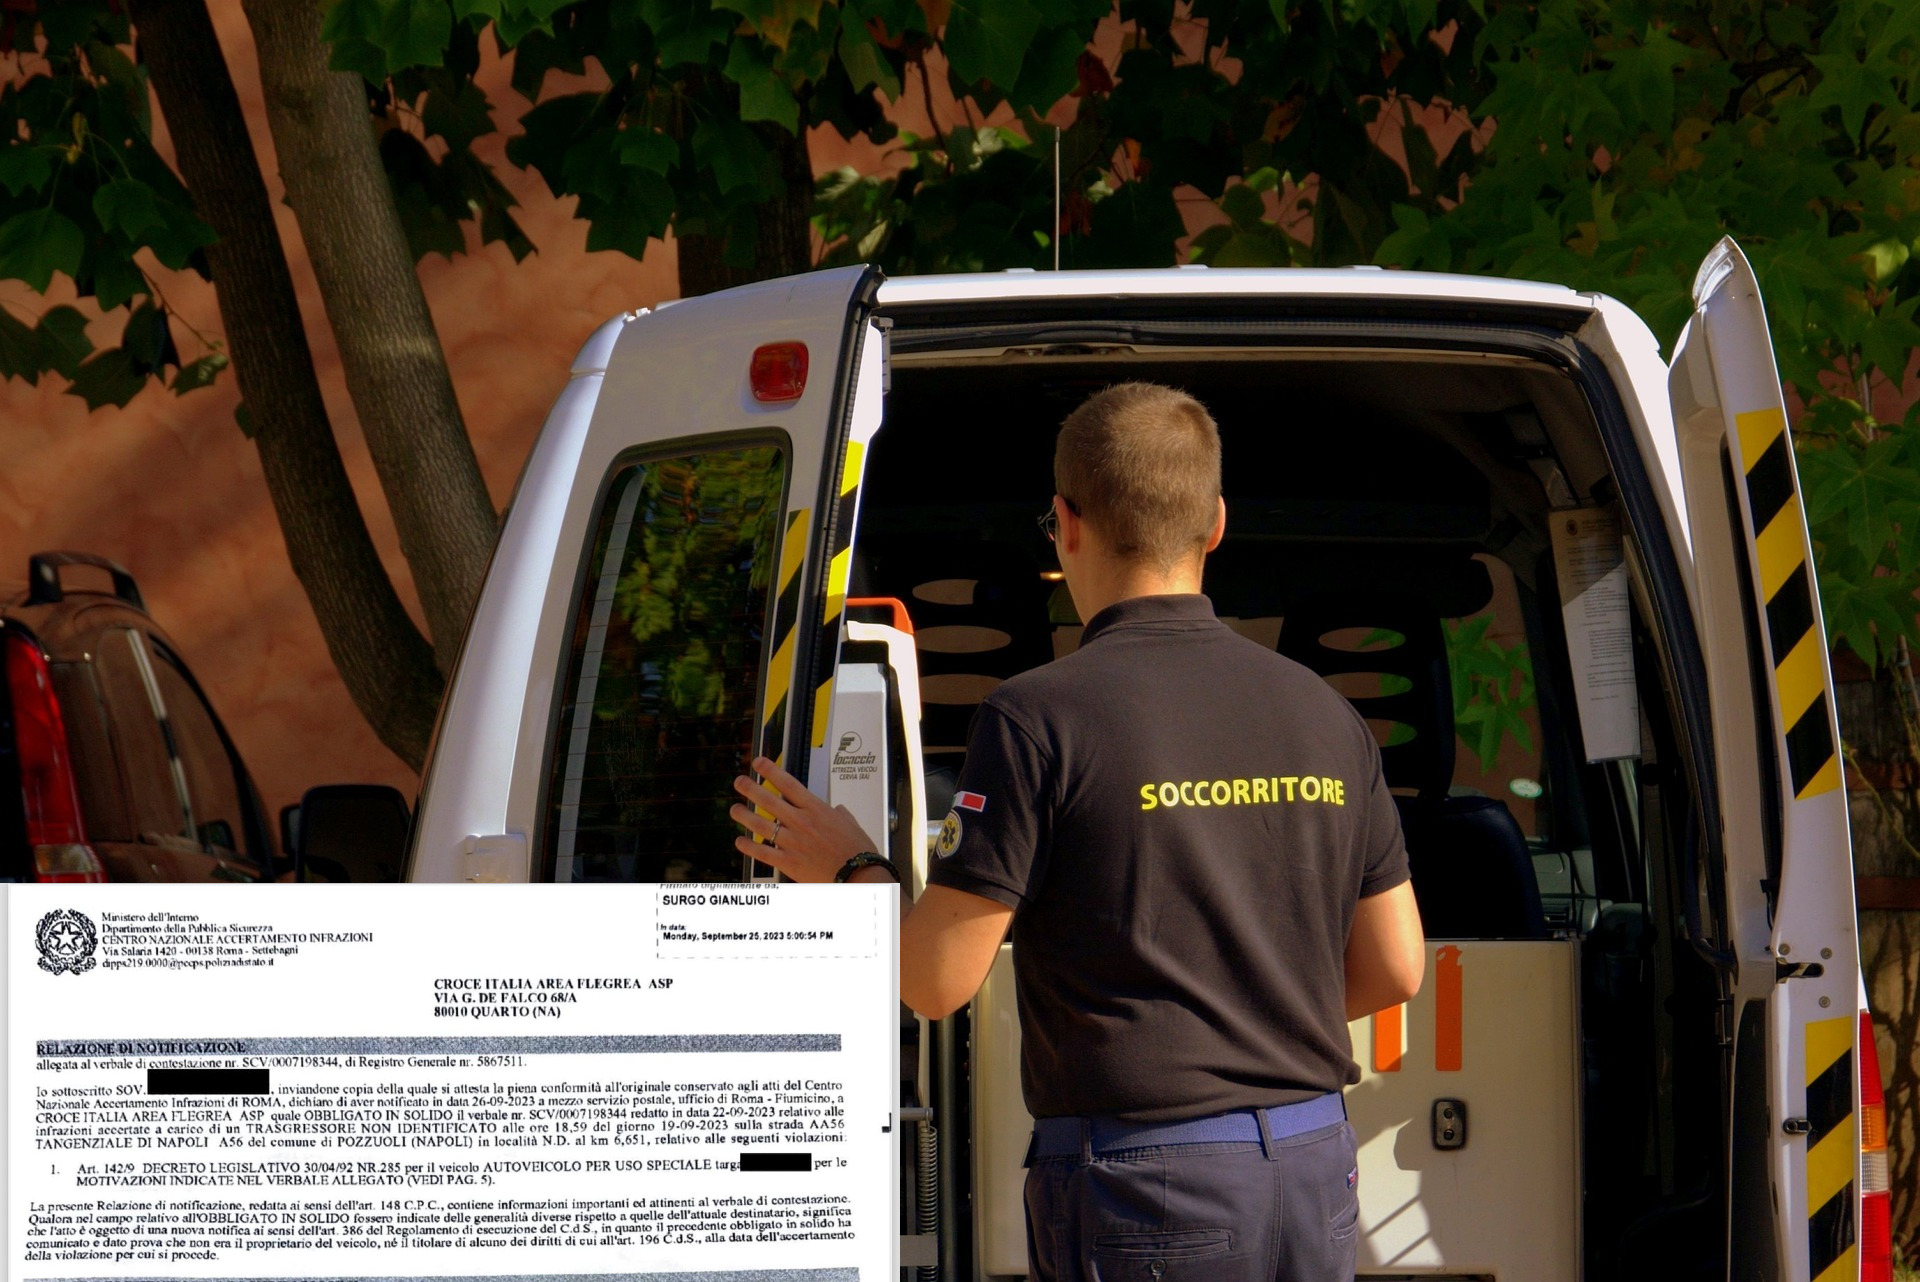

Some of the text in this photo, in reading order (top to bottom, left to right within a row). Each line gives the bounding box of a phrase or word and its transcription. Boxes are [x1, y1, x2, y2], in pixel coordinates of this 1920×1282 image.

[1140, 776, 1345, 811] SOCCORRITORE
[663, 895, 769, 905] SURGO GIANLUIGI
[102, 912, 199, 922] Ministero dell'Interno
[102, 923, 272, 935] Dipartimento della Pubblica Sicurezza
[102, 932, 372, 944] CENTRO NAZIONALE ACCERTAMENTO INFRAZIONI
[663, 932, 699, 942] Monday,
[702, 932, 747, 942] September
[749, 932, 761, 940] 25,
[764, 932, 784, 940] 2023
[820, 931, 833, 939] PM
[102, 947, 118, 956] Via
[122, 946, 152, 956] Salaria
[156, 946, 176, 956] 1420
[186, 946, 213, 955] 00138
[216, 945, 243, 955] Roma
[252, 945, 299, 956] Settebagni
[434, 978, 673, 990] CROCE ITALIA AREA FLEGREA ASP
[434, 992, 576, 1003] VIA G. DE FALCO 68/A
[434, 1006, 560, 1019] 80010 QUARTO (NA)
[36, 1042, 246, 1055] RELAZIONE DI NOTIFICAZIONE
[36, 1055, 526, 1071] allegata al verbale di contestazione nr. SCV/0007198344, di Registro Generale nr. 5867511.
[37, 1084, 146, 1097] Io sottoscritto SOV.
[279, 1080, 842, 1096] inviandone copia della quale si attesta la piena conformità all'originale conservato agli atti del Centro
[36, 1106, 844, 1123] CROCE ITALIA AREA FLEGREA ASP quale OBBLIGATO IN SOLIDO il verbale nr. SCV/0007198344 redatto in data 22-09-2023 relativo alle
[52, 1164, 59, 1175] 1.
[78, 1164, 98, 1174] Art.
[105, 1163, 134, 1174] 142/9
[143, 1162, 206, 1173] DECRETO
[210, 1162, 300, 1173] LEGISLATIVO
[304, 1162, 352, 1173] 30/04/92
[357, 1162, 400, 1173] NR.285
[405, 1165, 423, 1174] per
[428, 1162, 434, 1173] il
[439, 1162, 479, 1173] veicolo
[484, 1161, 581, 1172] AUTOVEICOLO
[586, 1160, 610, 1171] PER
[616, 1160, 642, 1171] USO
[647, 1159, 712, 1171] SPECIALE
[815, 1157, 847, 1170] per le
[77, 1174, 495, 1187] MOTIVAZIONI INDICATE NEL VERBALE ALLEGATO (VEDI PAG. 5).
[31, 1194, 850, 1214] La presente Relazione di notificazione, redatta ai sensi dell'art. 148 C.P.C., contiene informazioni importanti ed attinenti al verbale di contestazione.
[25, 1251, 51, 1261] della
[56, 1250, 112, 1260] violazione
[116, 1252, 134, 1262] per
[172, 1250, 218, 1262] procede.
